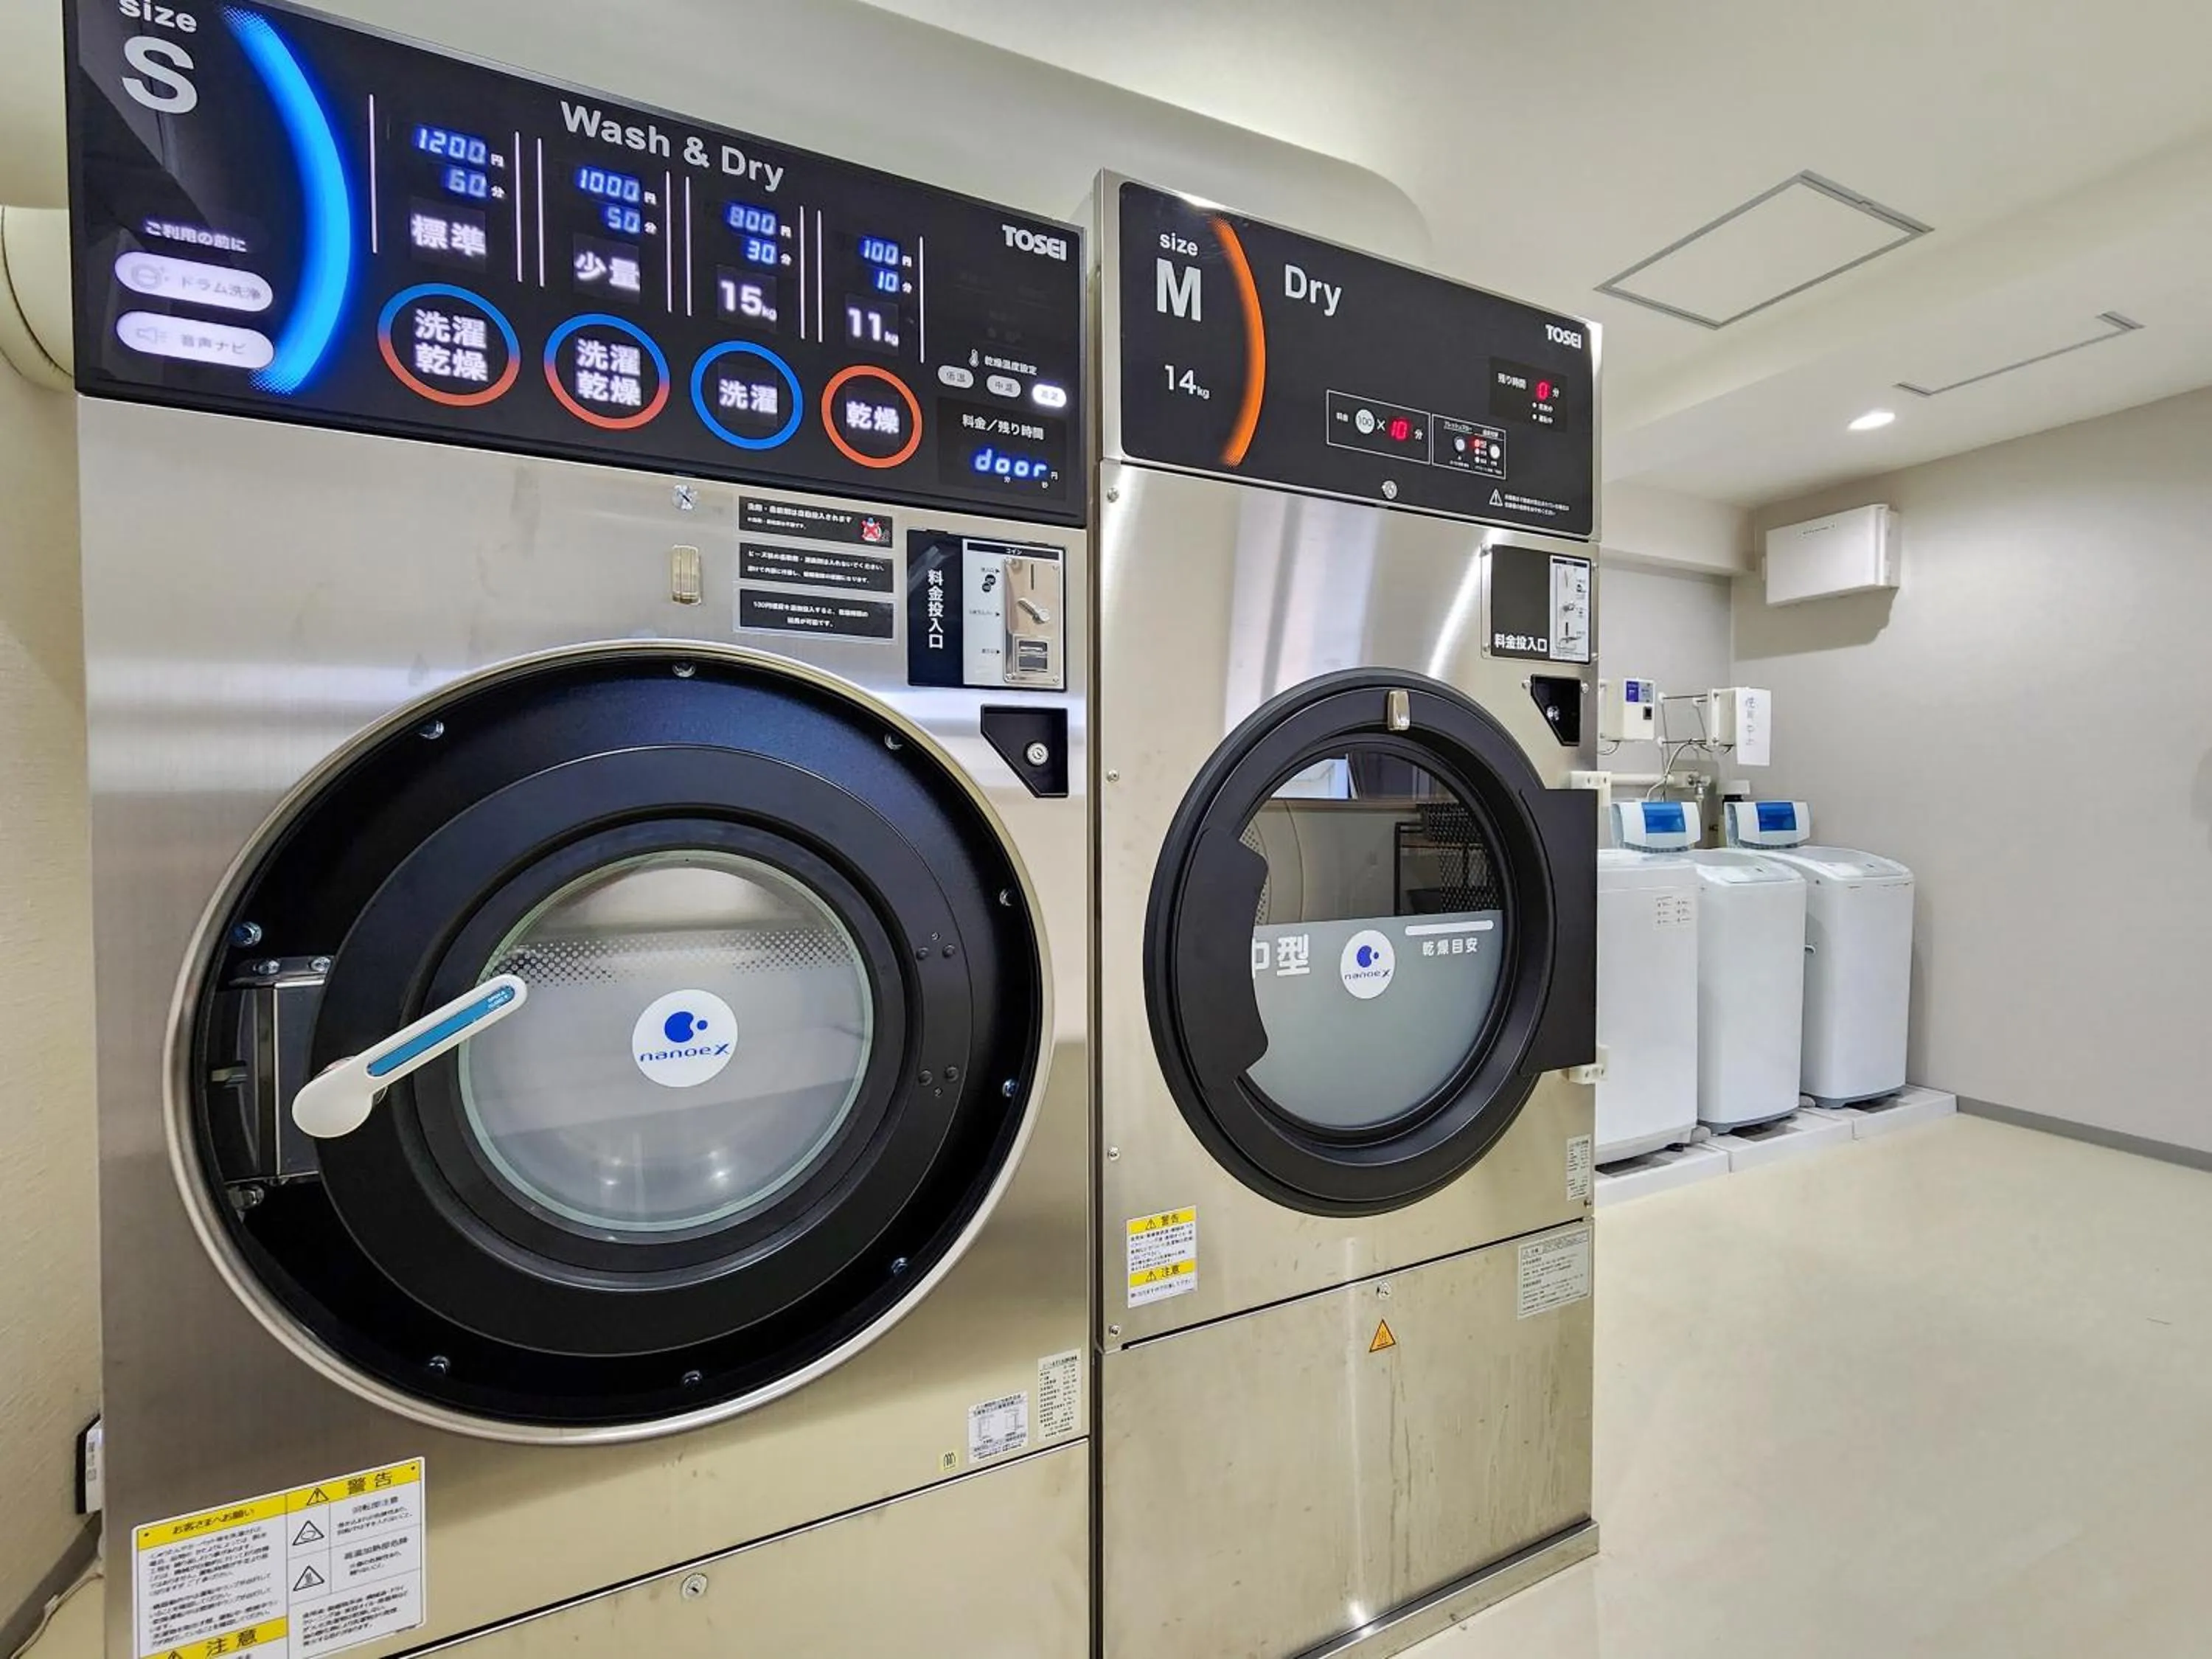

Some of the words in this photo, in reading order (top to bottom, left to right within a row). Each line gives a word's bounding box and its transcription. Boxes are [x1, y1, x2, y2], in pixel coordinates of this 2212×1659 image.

[119, 0, 197, 33] size
[122, 36, 198, 114] S
[417, 127, 486, 164] 1200
[490, 153, 504, 167] 円
[560, 101, 670, 157] Wash
[684, 136, 709, 168] &
[722, 147, 784, 192] Dry
[448, 170, 486, 198] 60
[491, 184, 505, 199] 分
[578, 168, 640, 203] 1000
[644, 192, 656, 205] 円
[146, 220, 248, 252] ご利用の前に
[411, 215, 486, 257] 標準
[606, 206, 640, 234] 50
[644, 221, 656, 234] 分
[728, 204, 776, 235] 800
[781, 225, 791, 238] 円
[746, 240, 776, 265] 30
[863, 237, 899, 265] 100
[902, 255, 912, 267] 円
[1002, 224, 1068, 260] TOSEI
[1160, 232, 1199, 257] size
[182, 276, 261, 301] ドラム洗浄
[576, 252, 640, 291] 少量
[875, 269, 898, 293] 10
[720, 281, 777, 322] 15kg
[1156, 257, 1202, 322] M
[1284, 264, 1343, 317] Dry
[181, 334, 248, 354] 音声ナビ
[414, 310, 487, 349] 洗濯
[847, 307, 900, 347] 11kg
[1545, 324, 1582, 349] TOSEI
[415, 342, 488, 382] 乾燥
[577, 338, 641, 374] 洗濯
[577, 371, 642, 406] 乾燥
[719, 380, 778, 414] 洗濯
[1164, 364, 1210, 400] 14kg
[846, 400, 900, 434] 乾燥
[975, 448, 1047, 477] door
[928, 569, 944, 650] 料金投入口
[1495, 633, 1548, 652] 料金投入口
[1422, 938, 1479, 956] 乾燥目安
[348, 1472, 392, 1495] 警告
[206, 1628, 257, 1657] 注意
